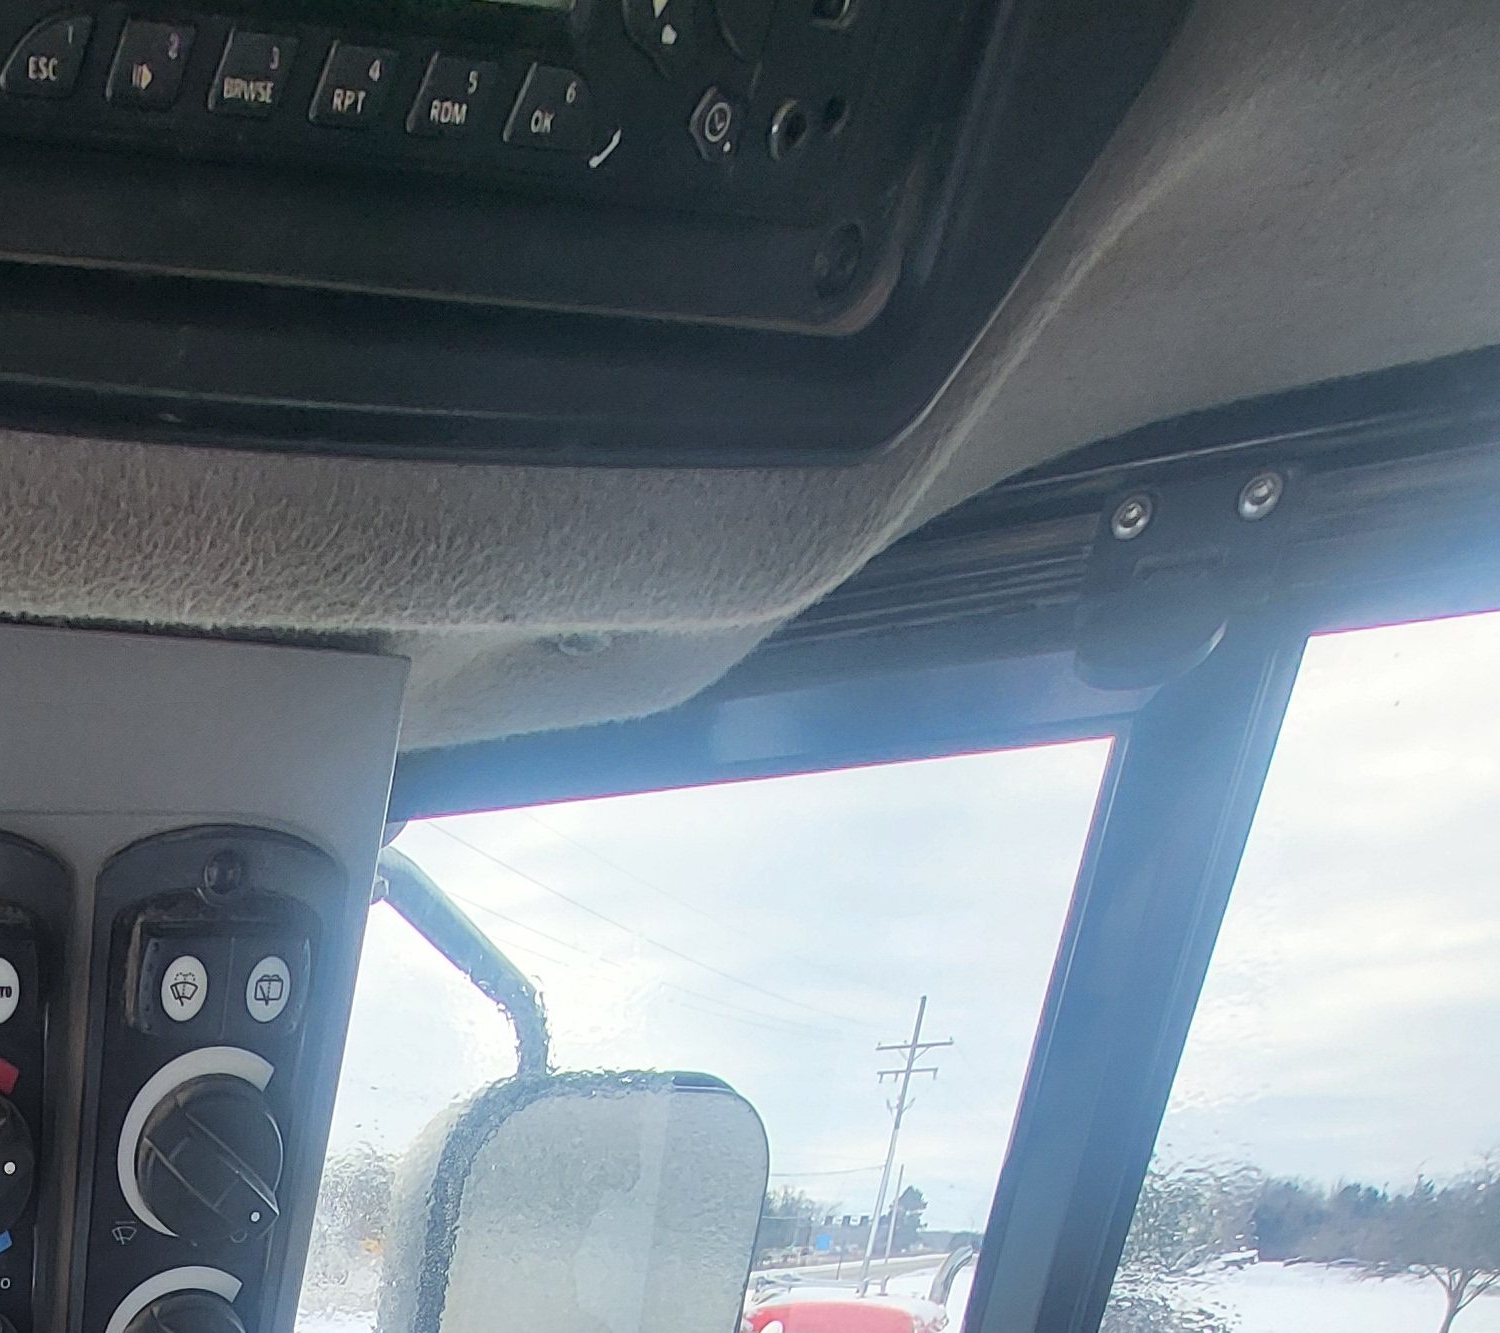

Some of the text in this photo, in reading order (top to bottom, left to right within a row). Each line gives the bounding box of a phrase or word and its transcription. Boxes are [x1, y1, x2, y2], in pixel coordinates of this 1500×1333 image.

[28, 56, 58, 81] ESC
[368, 59, 381, 82] 4
[223, 77, 274, 103] BRWSE
[467, 70, 479, 95] 5
[565, 80, 577, 104] 6
[332, 88, 366, 114] RPT
[429, 99, 468, 125] RDM
[530, 109, 554, 133] OK
